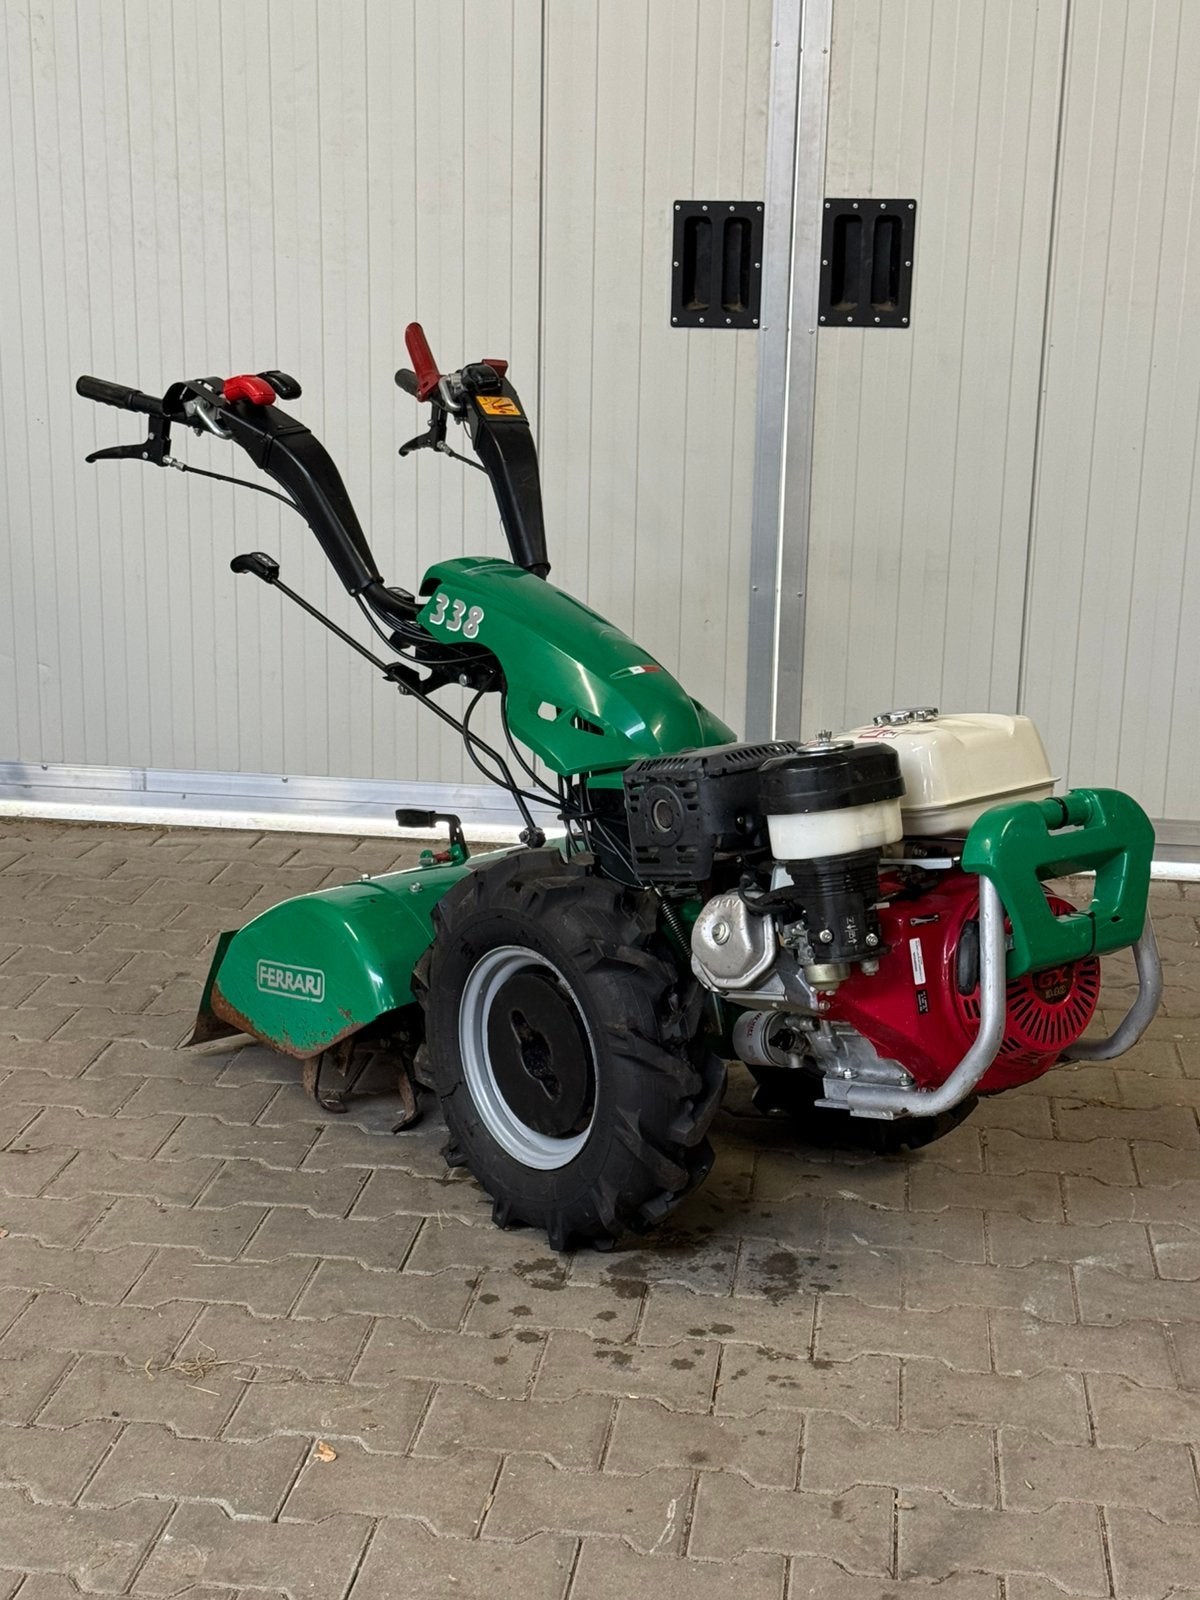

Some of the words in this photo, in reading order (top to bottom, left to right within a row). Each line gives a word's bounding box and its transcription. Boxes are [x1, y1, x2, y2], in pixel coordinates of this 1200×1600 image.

[429, 592, 485, 639] 338
[260, 965, 321, 996] FERRARI
[1039, 965, 1068, 988] GX
